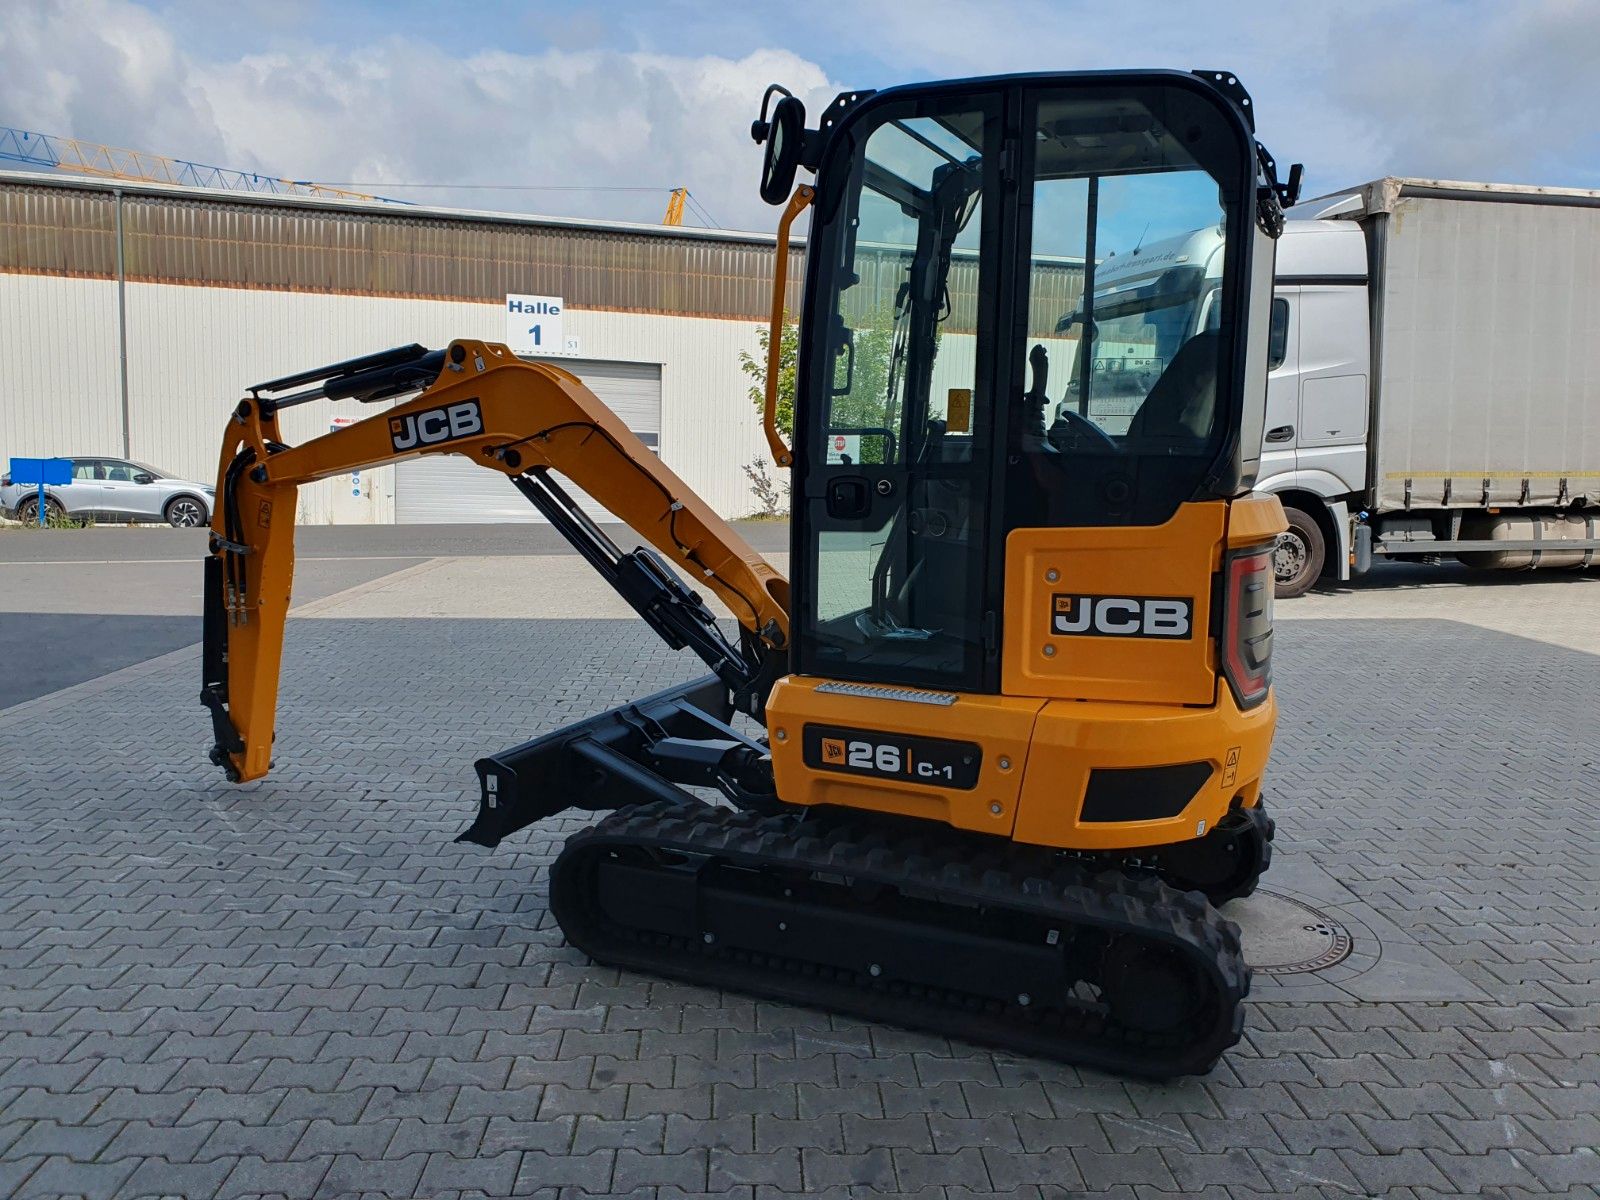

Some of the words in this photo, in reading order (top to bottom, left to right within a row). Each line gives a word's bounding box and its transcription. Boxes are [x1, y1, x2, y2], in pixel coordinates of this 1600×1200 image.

[509, 300, 560, 315] Halle
[529, 324, 541, 345] 1
[393, 402, 481, 449] JCB
[1055, 598, 1189, 635] JCB
[848, 741, 900, 772] 26
[917, 762, 953, 780] C-1
